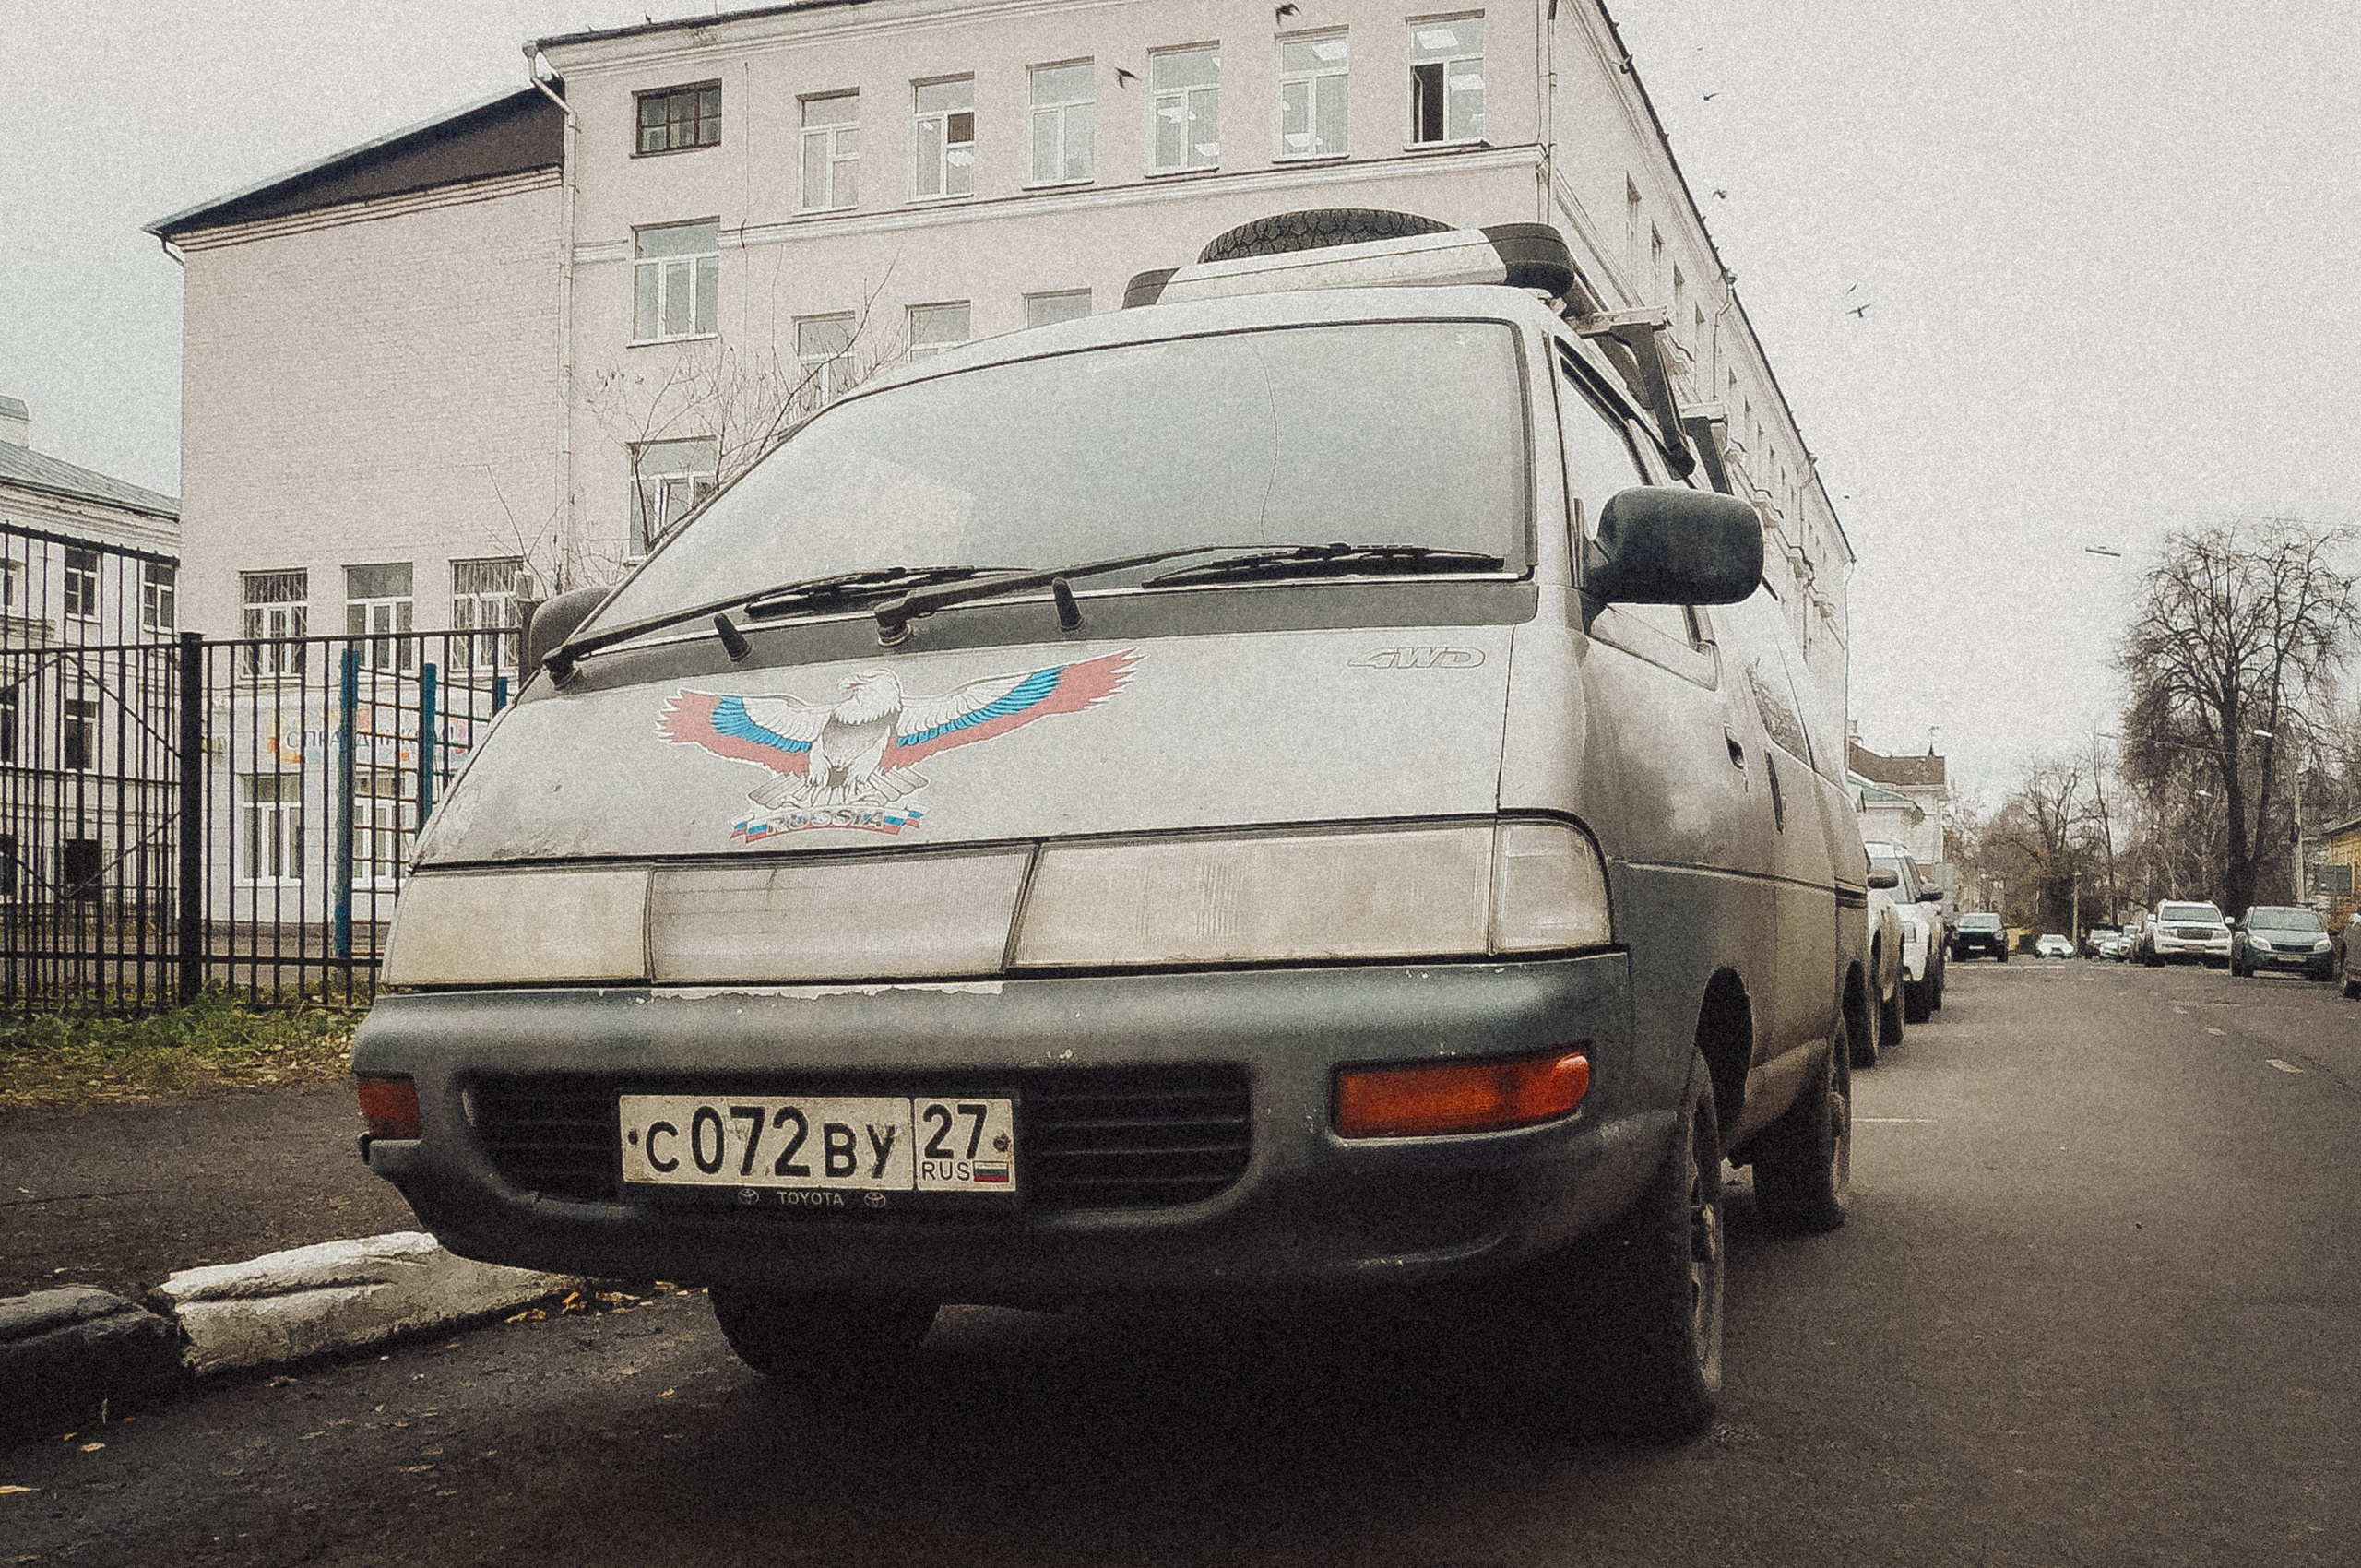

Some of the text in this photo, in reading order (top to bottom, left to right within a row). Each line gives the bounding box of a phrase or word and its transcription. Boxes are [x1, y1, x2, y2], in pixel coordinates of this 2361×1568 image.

[1347, 646, 1486, 670] 4WD
[767, 808, 884, 834] RUSSIA
[921, 1103, 989, 1160] 27
[921, 1161, 971, 1182] RUS
[777, 1191, 845, 1206] TOYOTA
